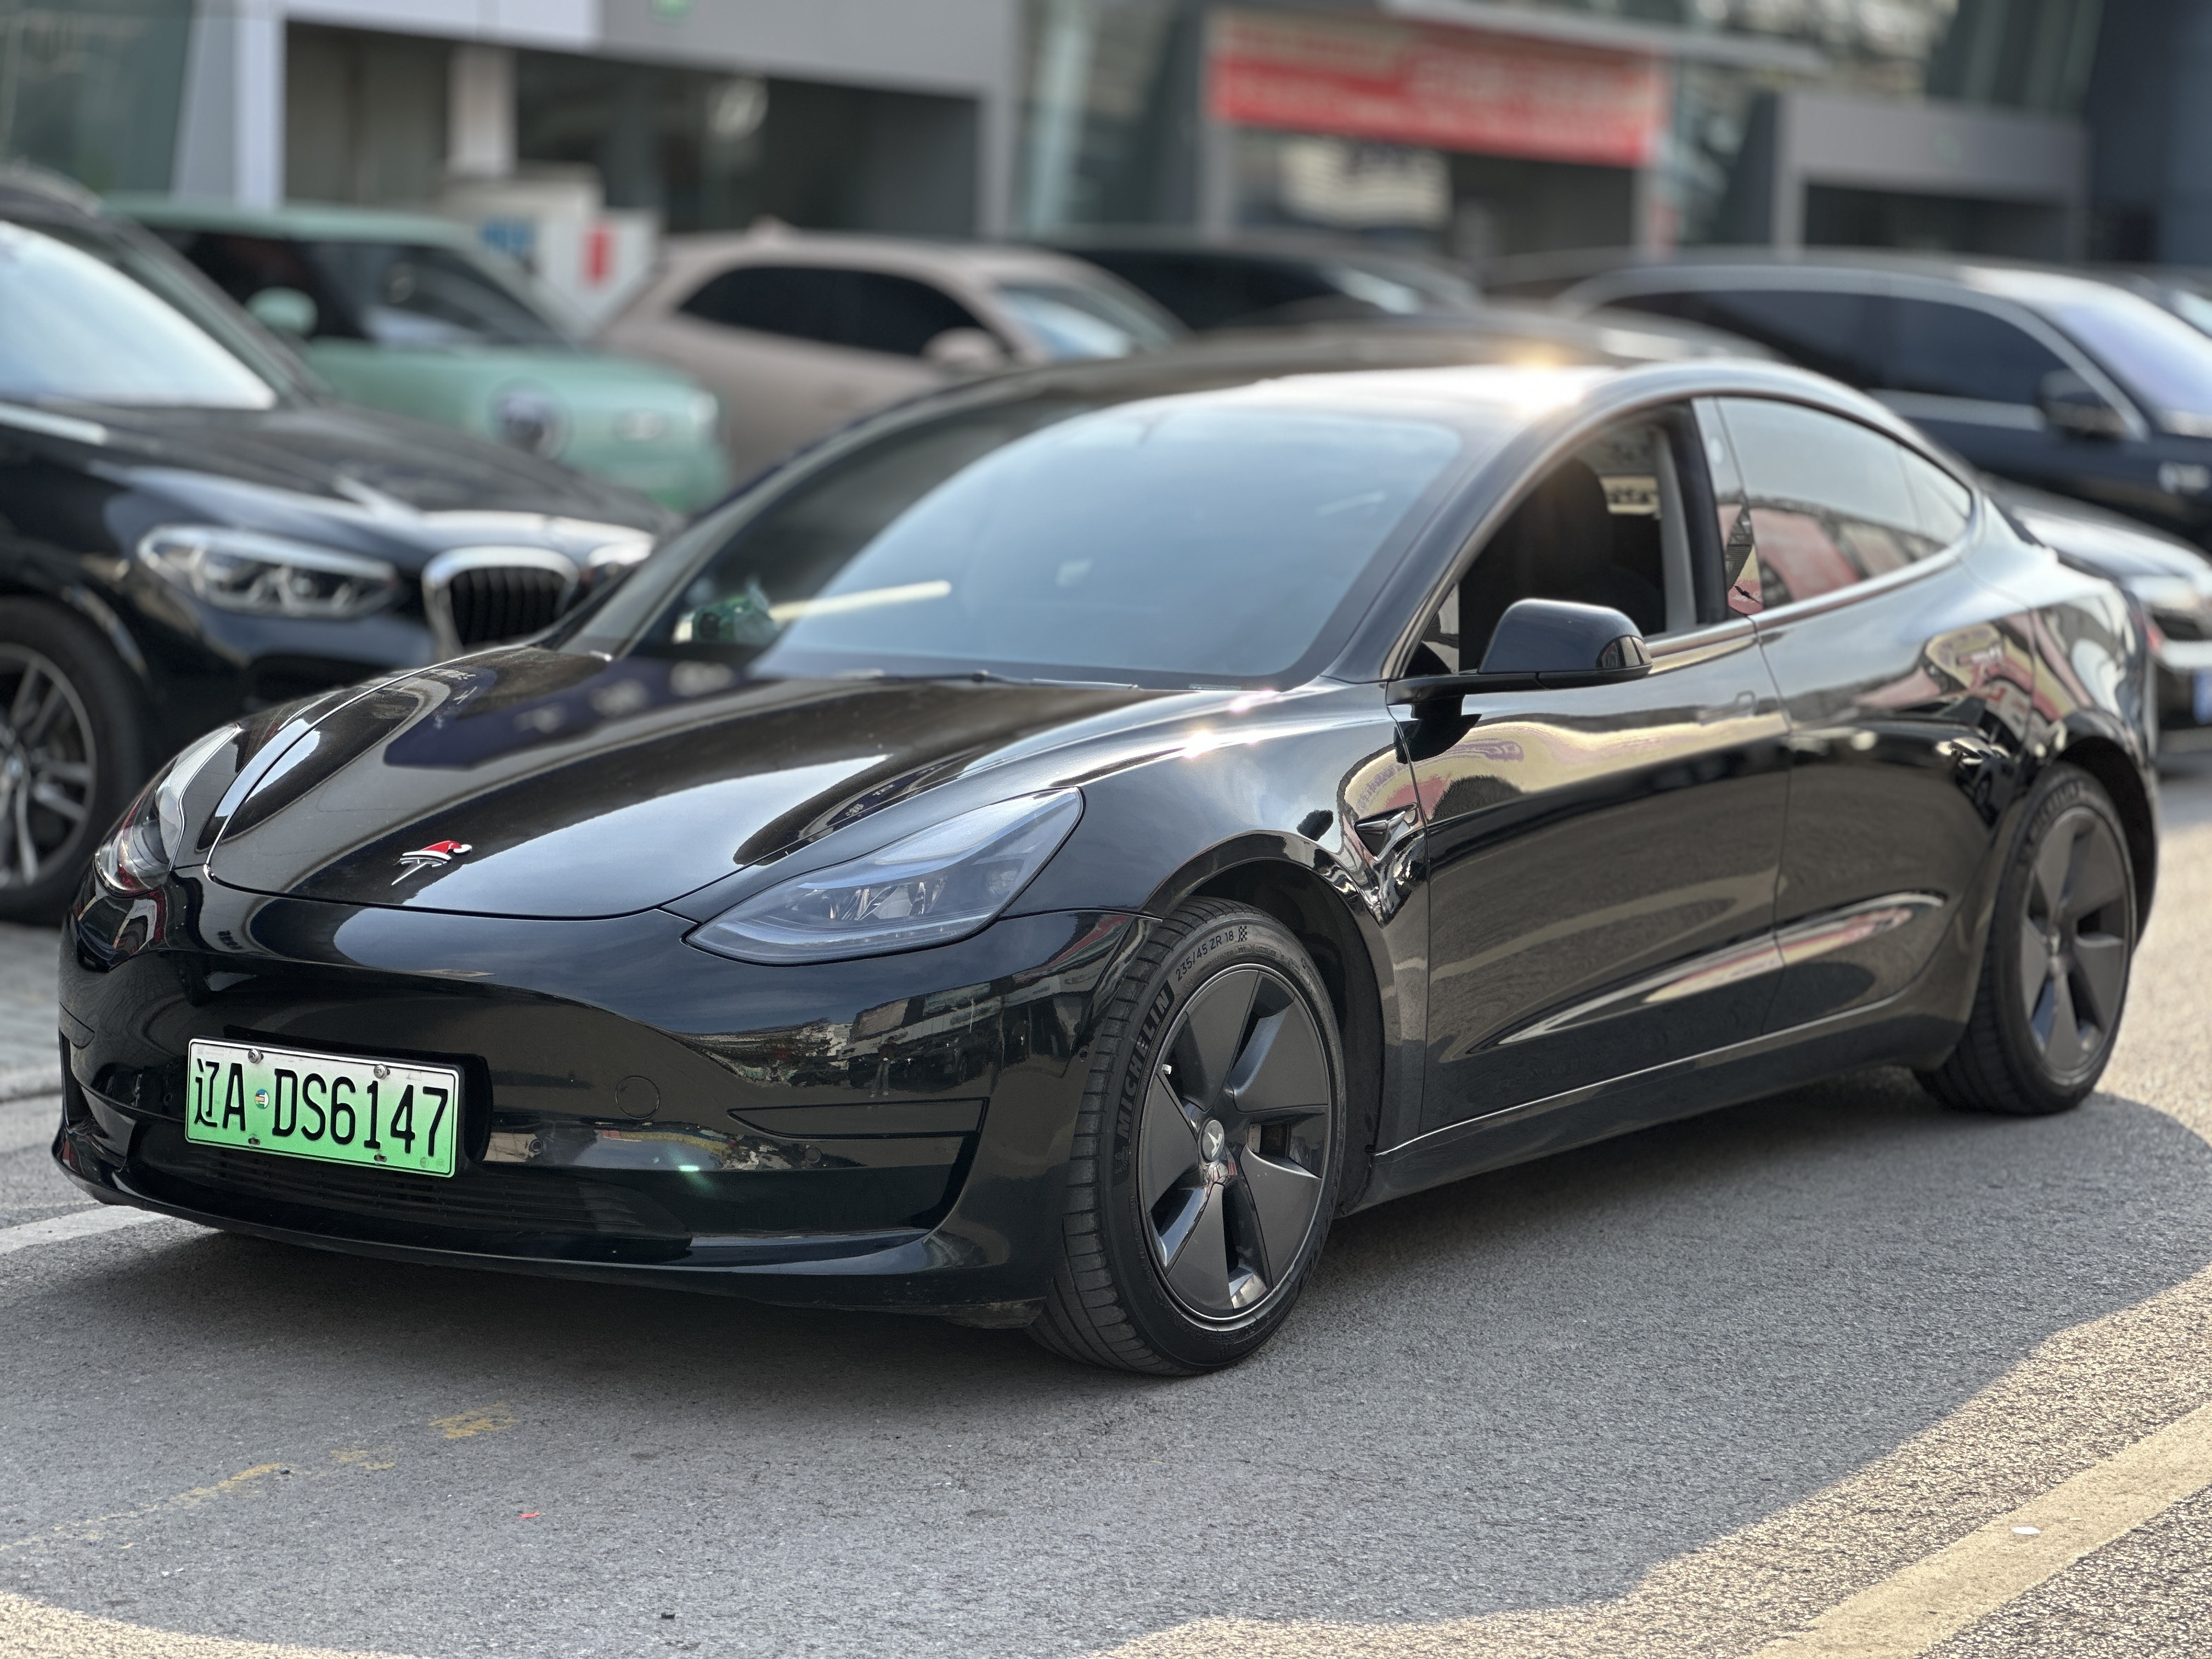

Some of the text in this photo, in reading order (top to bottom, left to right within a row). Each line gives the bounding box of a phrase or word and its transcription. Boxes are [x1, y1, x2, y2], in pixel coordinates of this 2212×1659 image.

[1175, 943, 1208, 982] 235/45
[1209, 935, 1222, 951] ZR
[1224, 930, 1234, 943] 18
[1116, 989, 1170, 1139] MICHELIN
[272, 1068, 449, 1157] DS6147
